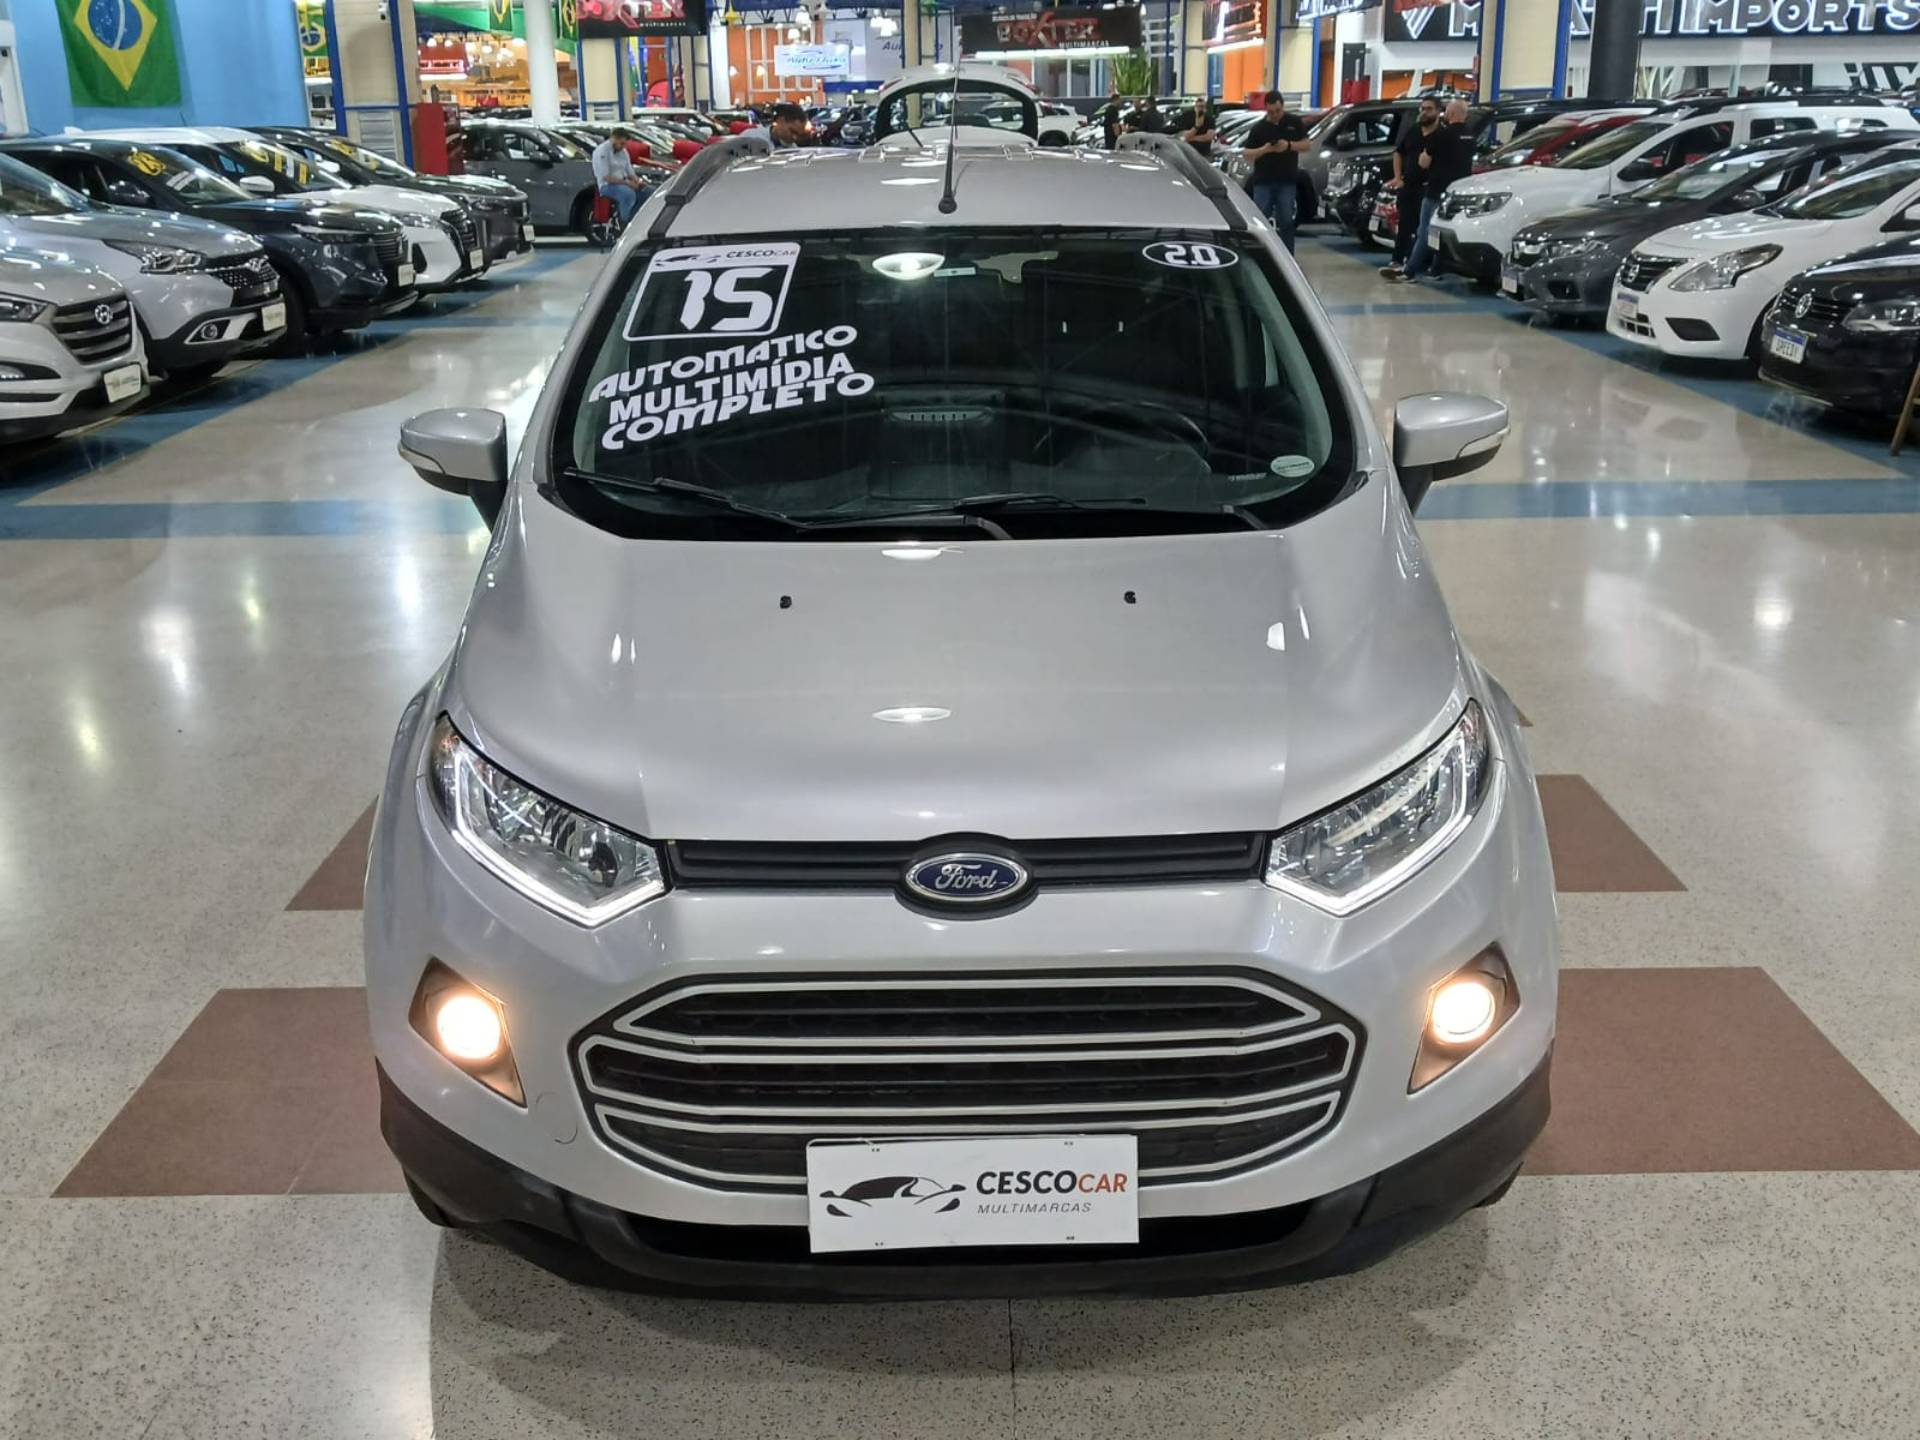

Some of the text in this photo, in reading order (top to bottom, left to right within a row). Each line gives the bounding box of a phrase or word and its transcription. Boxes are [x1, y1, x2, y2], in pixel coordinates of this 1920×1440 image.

[1163, 244, 1221, 266] 2.0
[680, 267, 775, 331] 15
[602, 373, 875, 450] COMPLETO
[609, 352, 855, 425] MULTIMÍDIA
[935, 862, 1003, 892] Ford
[977, 1202, 1092, 1215] MULTIMARCAS
